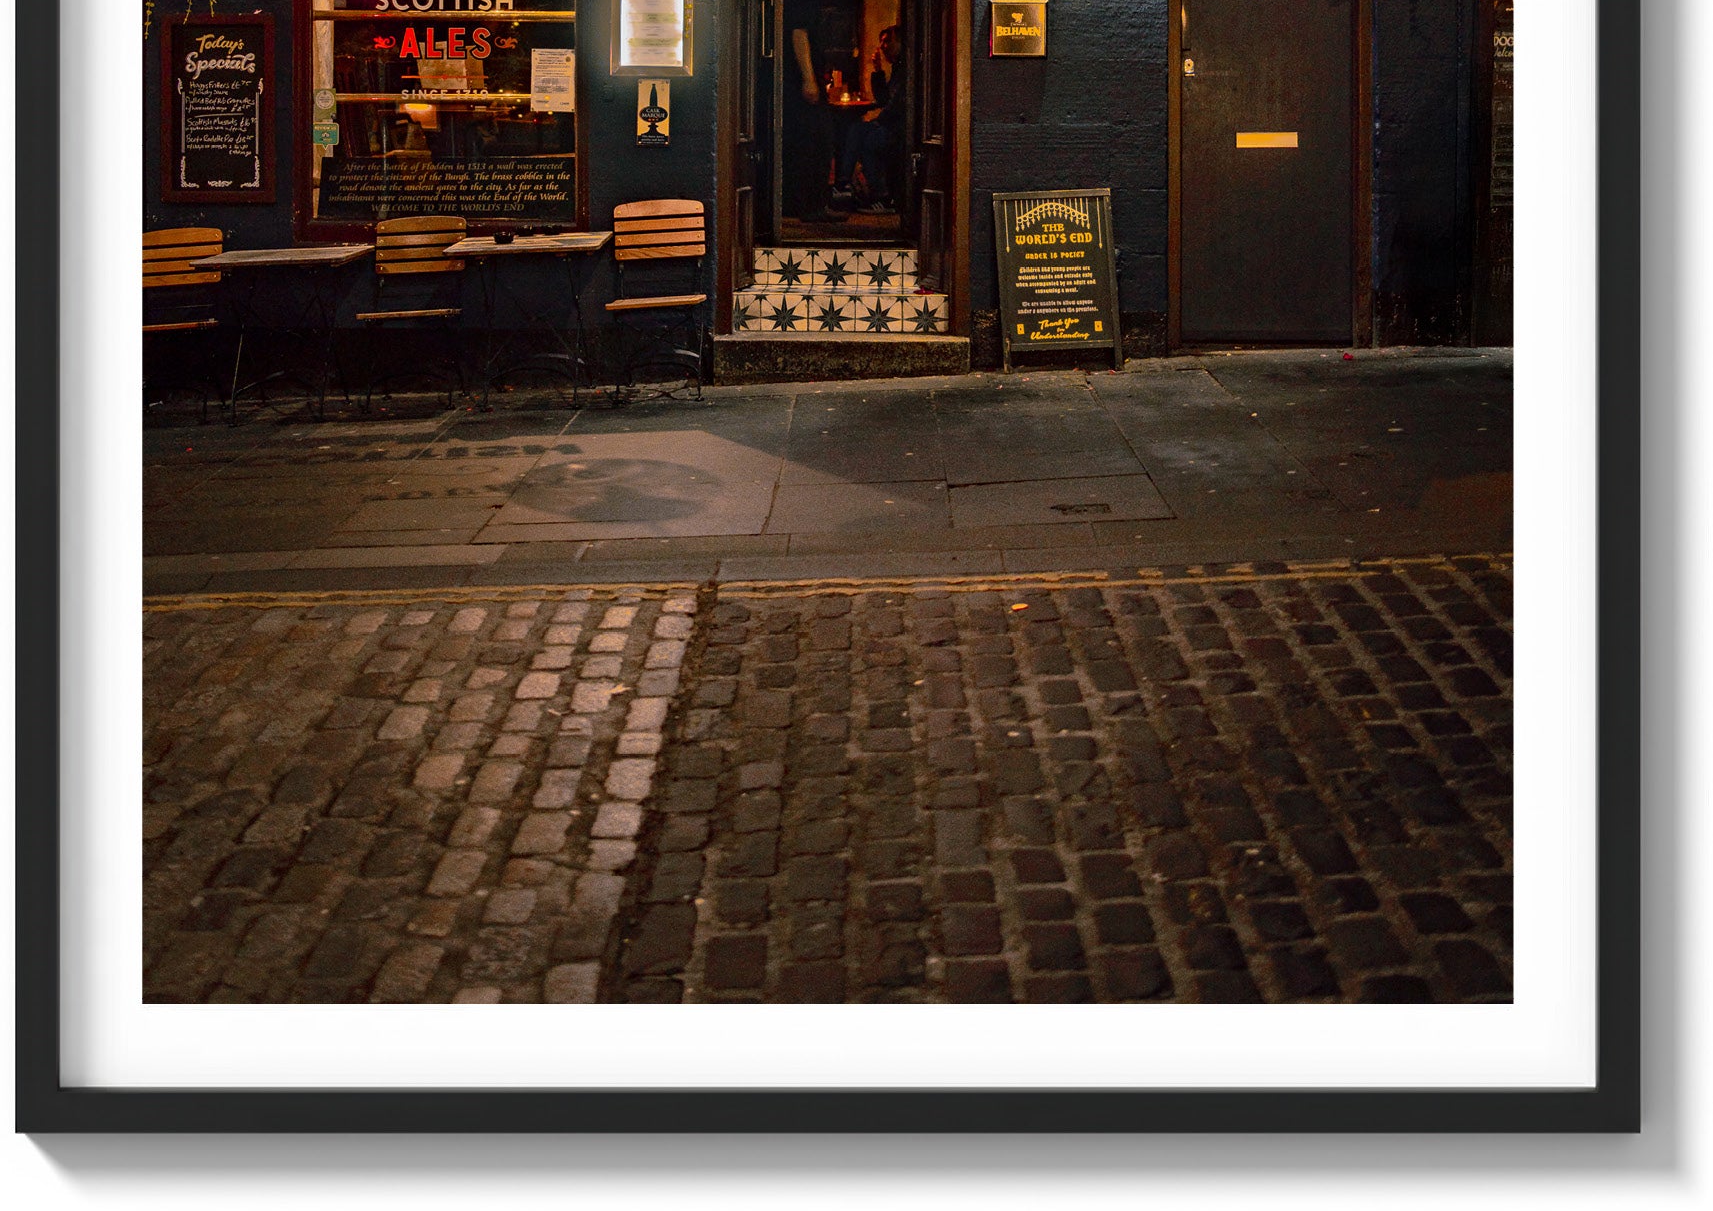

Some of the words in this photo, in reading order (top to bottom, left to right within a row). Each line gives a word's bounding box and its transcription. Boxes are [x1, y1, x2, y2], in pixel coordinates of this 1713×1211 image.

[996, 26, 1041, 37] BELHAVEN
[195, 34, 245, 54] Today's
[399, 27, 492, 60] ALES
[185, 51, 256, 80] Specials
[401, 90, 448, 100] SINCE
[474, 173, 489, 181] The
[557, 171, 570, 180] the
[545, 181, 559, 190] the
[478, 192, 491, 201] the
[494, 192, 510, 201] End
[523, 192, 537, 201] the
[1041, 223, 1065, 232] THE
[1015, 233, 1067, 245] WORLD'S
[1069, 232, 1093, 243] END
[1038, 318, 1063, 330] Thank
